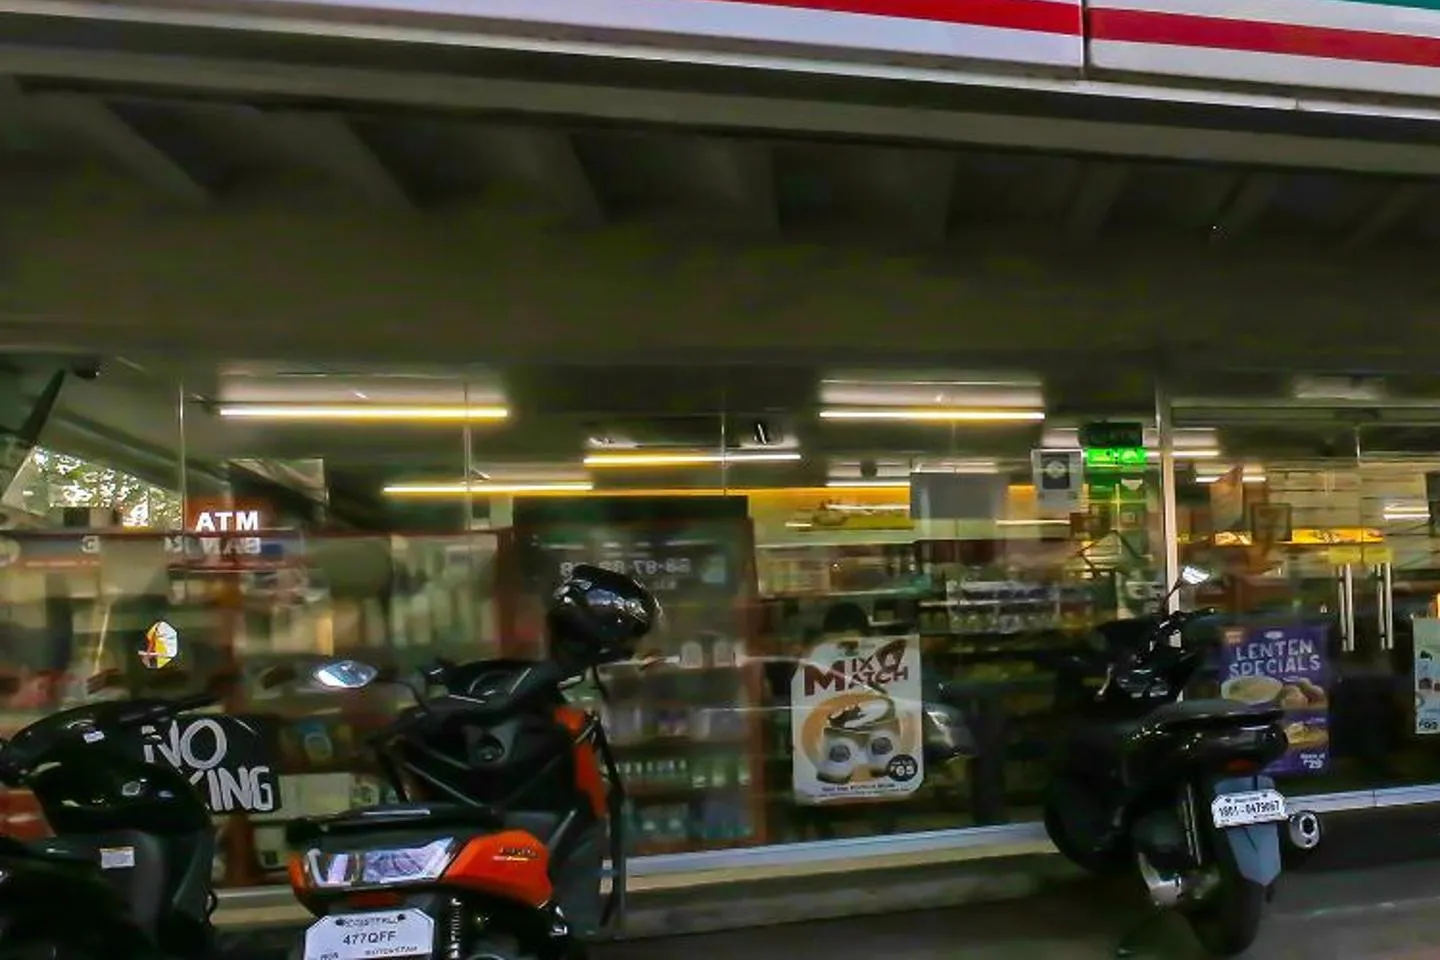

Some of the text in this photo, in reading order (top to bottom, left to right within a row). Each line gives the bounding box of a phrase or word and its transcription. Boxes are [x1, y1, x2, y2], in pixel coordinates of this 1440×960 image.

[195, 510, 260, 532] ATM
[1235, 639, 1313, 662] LENTEN
[1228, 654, 1322, 679] SPECIALS
[141, 718, 228, 770] NO
[343, 930, 397, 945] 477QFF
